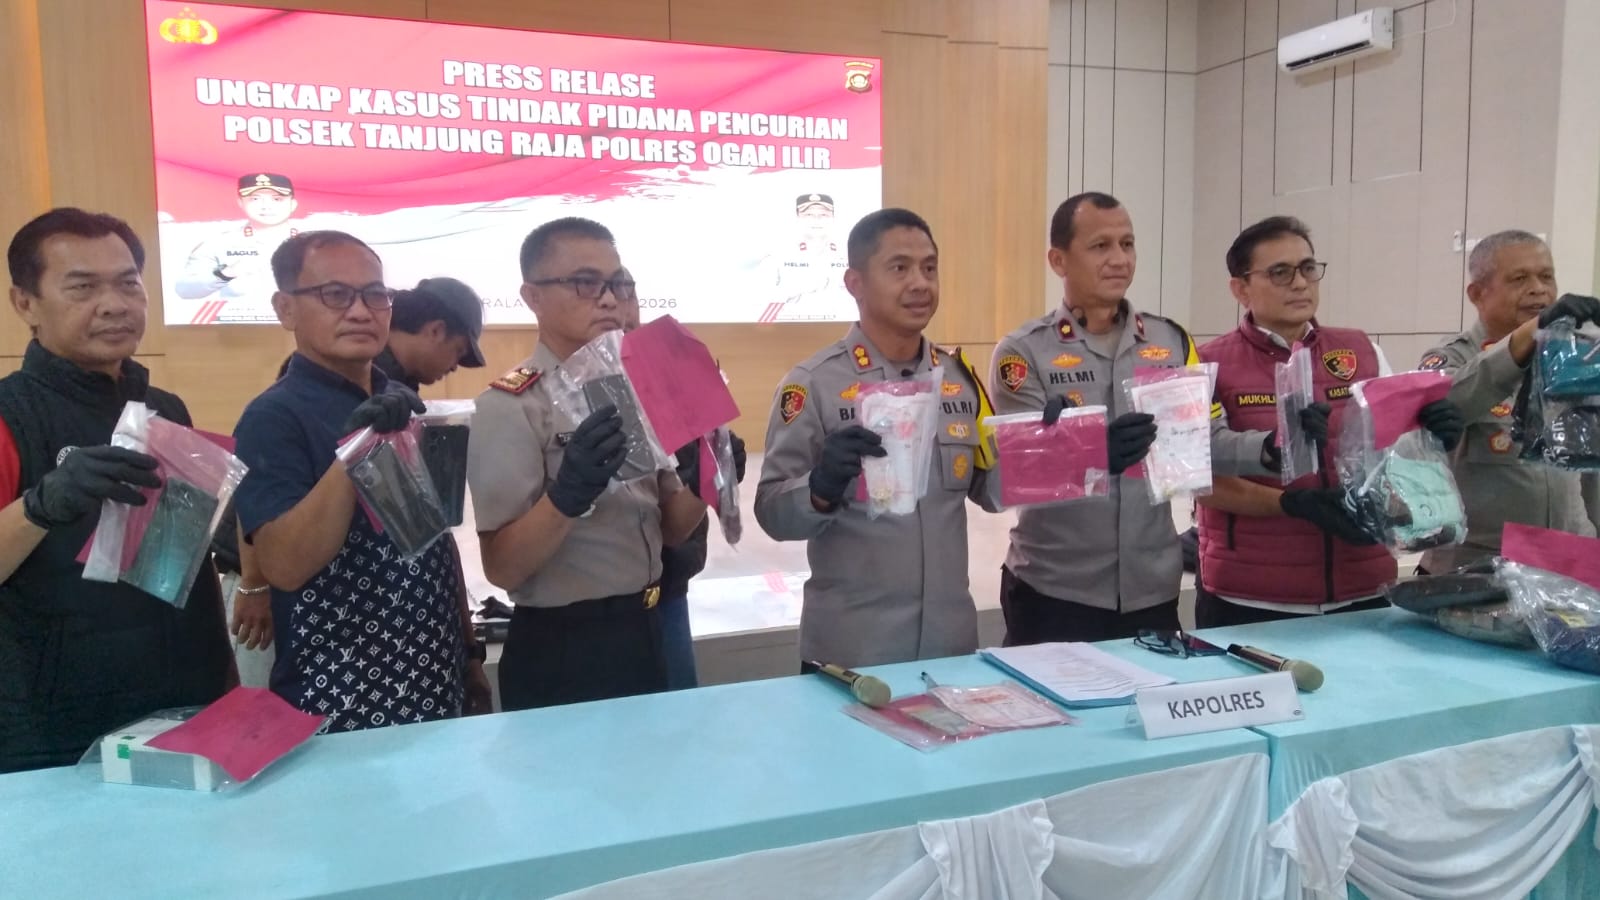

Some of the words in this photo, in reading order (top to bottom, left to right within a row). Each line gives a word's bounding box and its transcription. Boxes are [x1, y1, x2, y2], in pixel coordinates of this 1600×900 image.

[442, 59, 543, 92] PRESS
[550, 67, 656, 99] RELASE
[195, 77, 342, 112] UNGKAP
[348, 87, 461, 118] KASUS
[466, 95, 582, 127] TINDAK
[588, 103, 695, 133] PIDANA
[700, 111, 848, 141] PENCURIAN
[223, 115, 356, 148] POLSEK
[360, 122, 504, 156] TANJUNG
[511, 131, 586, 160] RAJA
[591, 137, 697, 165] POLRES
[700, 141, 776, 169] OGAN
[782, 146, 831, 170] ILIR
[639, 298, 678, 309] 2026
[1049, 370, 1096, 385] HELMI
[938, 401, 974, 415] OLRI
[1166, 689, 1266, 721] KAPOLRES
